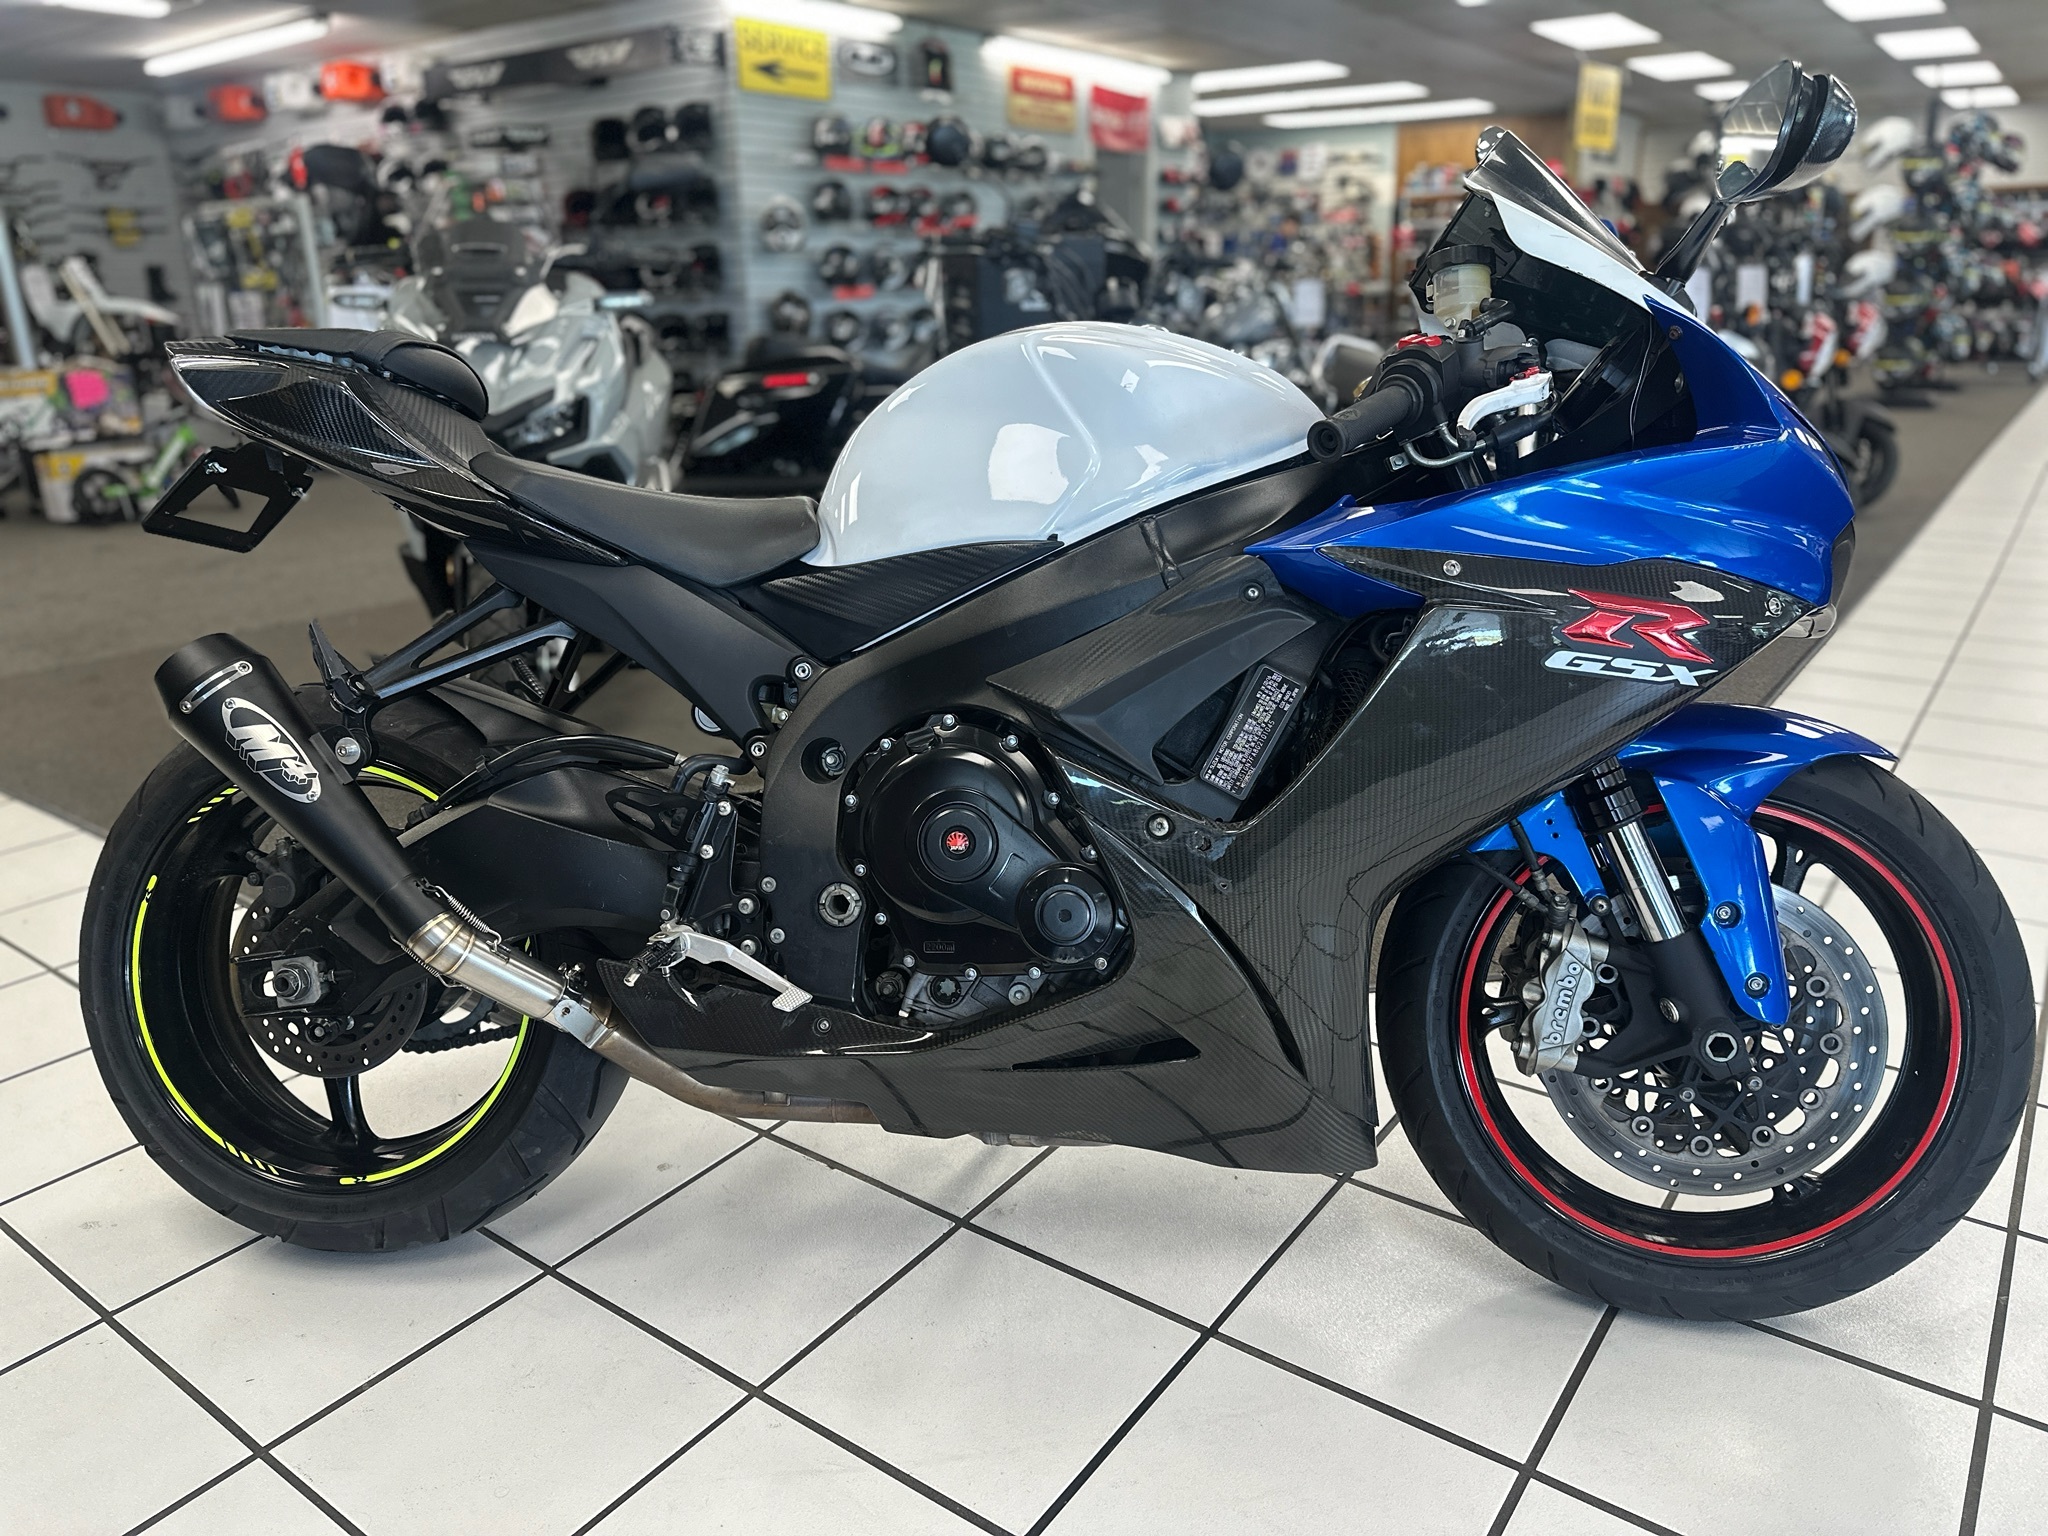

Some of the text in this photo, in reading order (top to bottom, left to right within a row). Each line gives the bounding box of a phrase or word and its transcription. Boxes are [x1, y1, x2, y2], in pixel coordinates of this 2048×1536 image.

[1561, 588, 1716, 664] R
[1545, 651, 1718, 687] GSX
[225, 723, 320, 785] M4
[1542, 961, 1581, 1045] brembo
